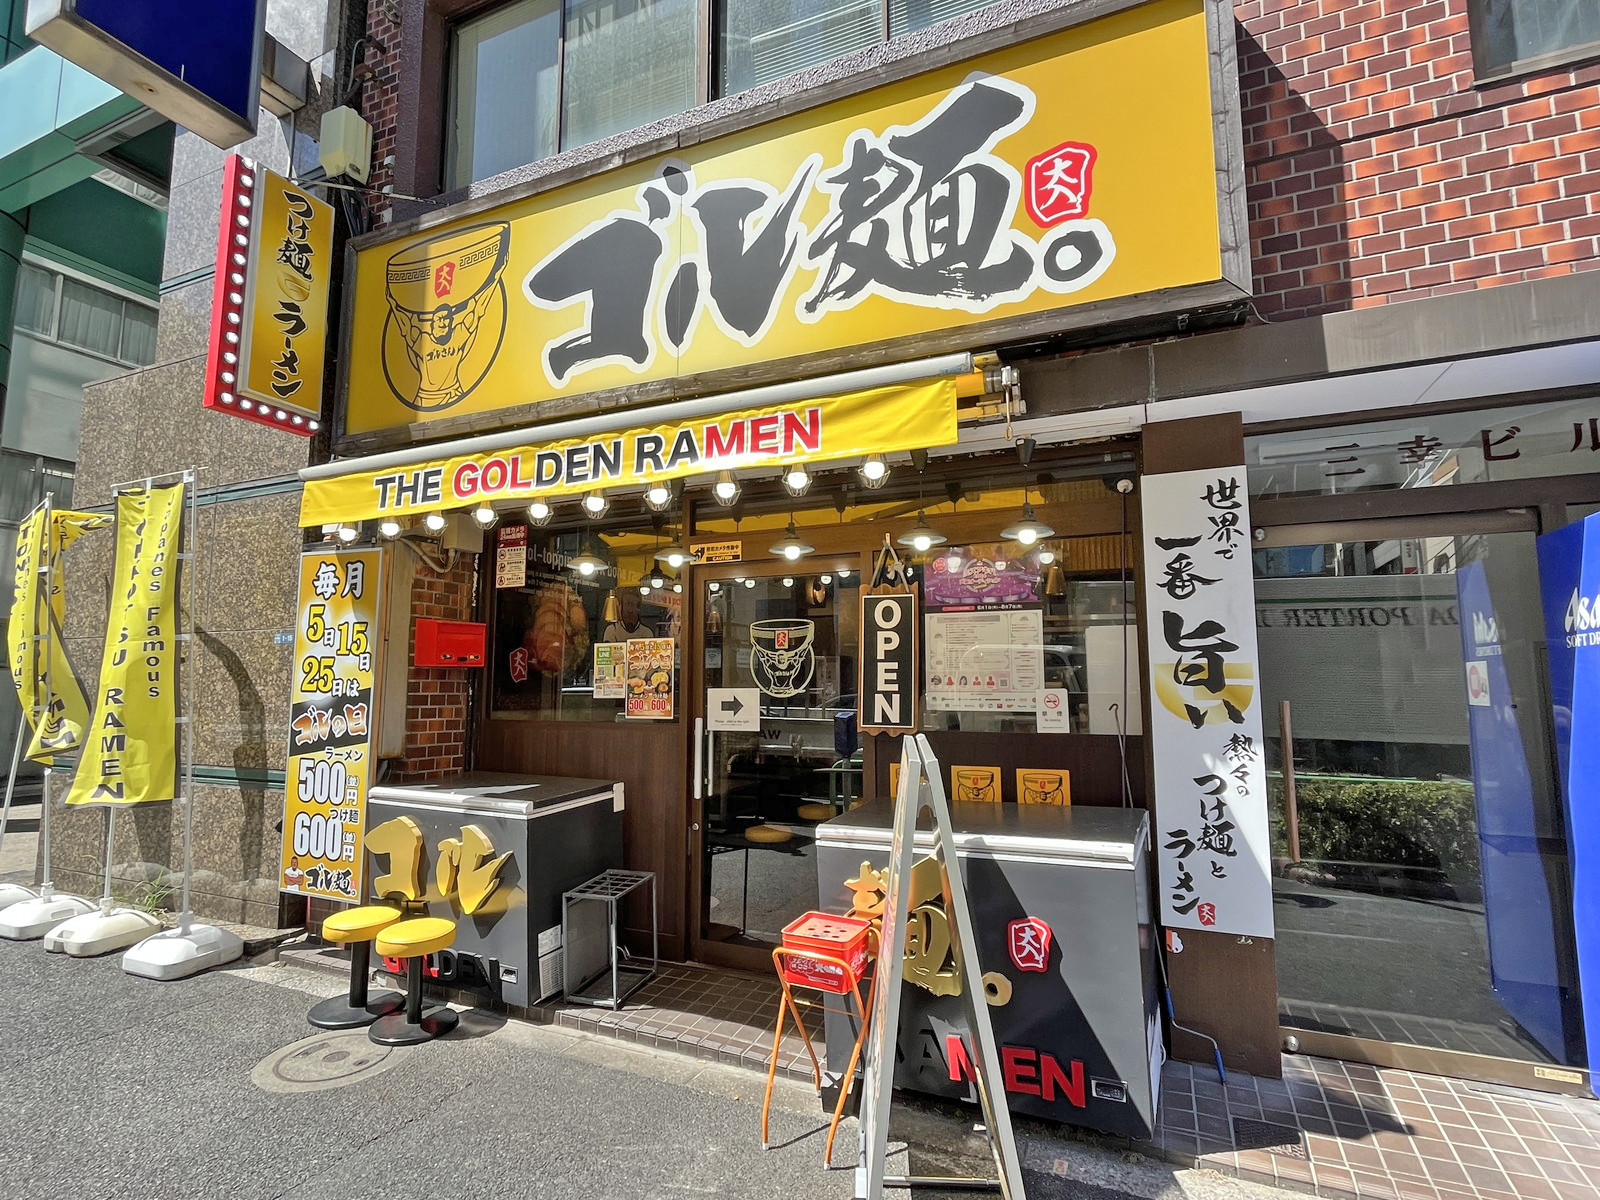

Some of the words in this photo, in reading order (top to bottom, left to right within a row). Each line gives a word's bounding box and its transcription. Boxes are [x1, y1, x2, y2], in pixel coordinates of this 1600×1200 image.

[277, 190, 314, 280] つけ麺
[271, 301, 307, 397] ラーメン
[374, 467, 443, 509] THE
[452, 440, 622, 498] GOLDEN
[634, 408, 820, 474] RAMEN
[1199, 476, 1245, 560] 世界で
[312, 559, 365, 600] 毎月
[143, 606, 165, 698] Famous
[873, 598, 903, 724] OPEN
[1154, 533, 1246, 731] 一番旨い
[1565, 633, 1588, 649] SOFT
[90, 687, 125, 800] RAMEN
[324, 747, 363, 762] ラーメン
[329, 808, 360, 824] つけ麺
[1193, 773, 1238, 879] つけ麺と
[1163, 828, 1201, 916] ラーメン
